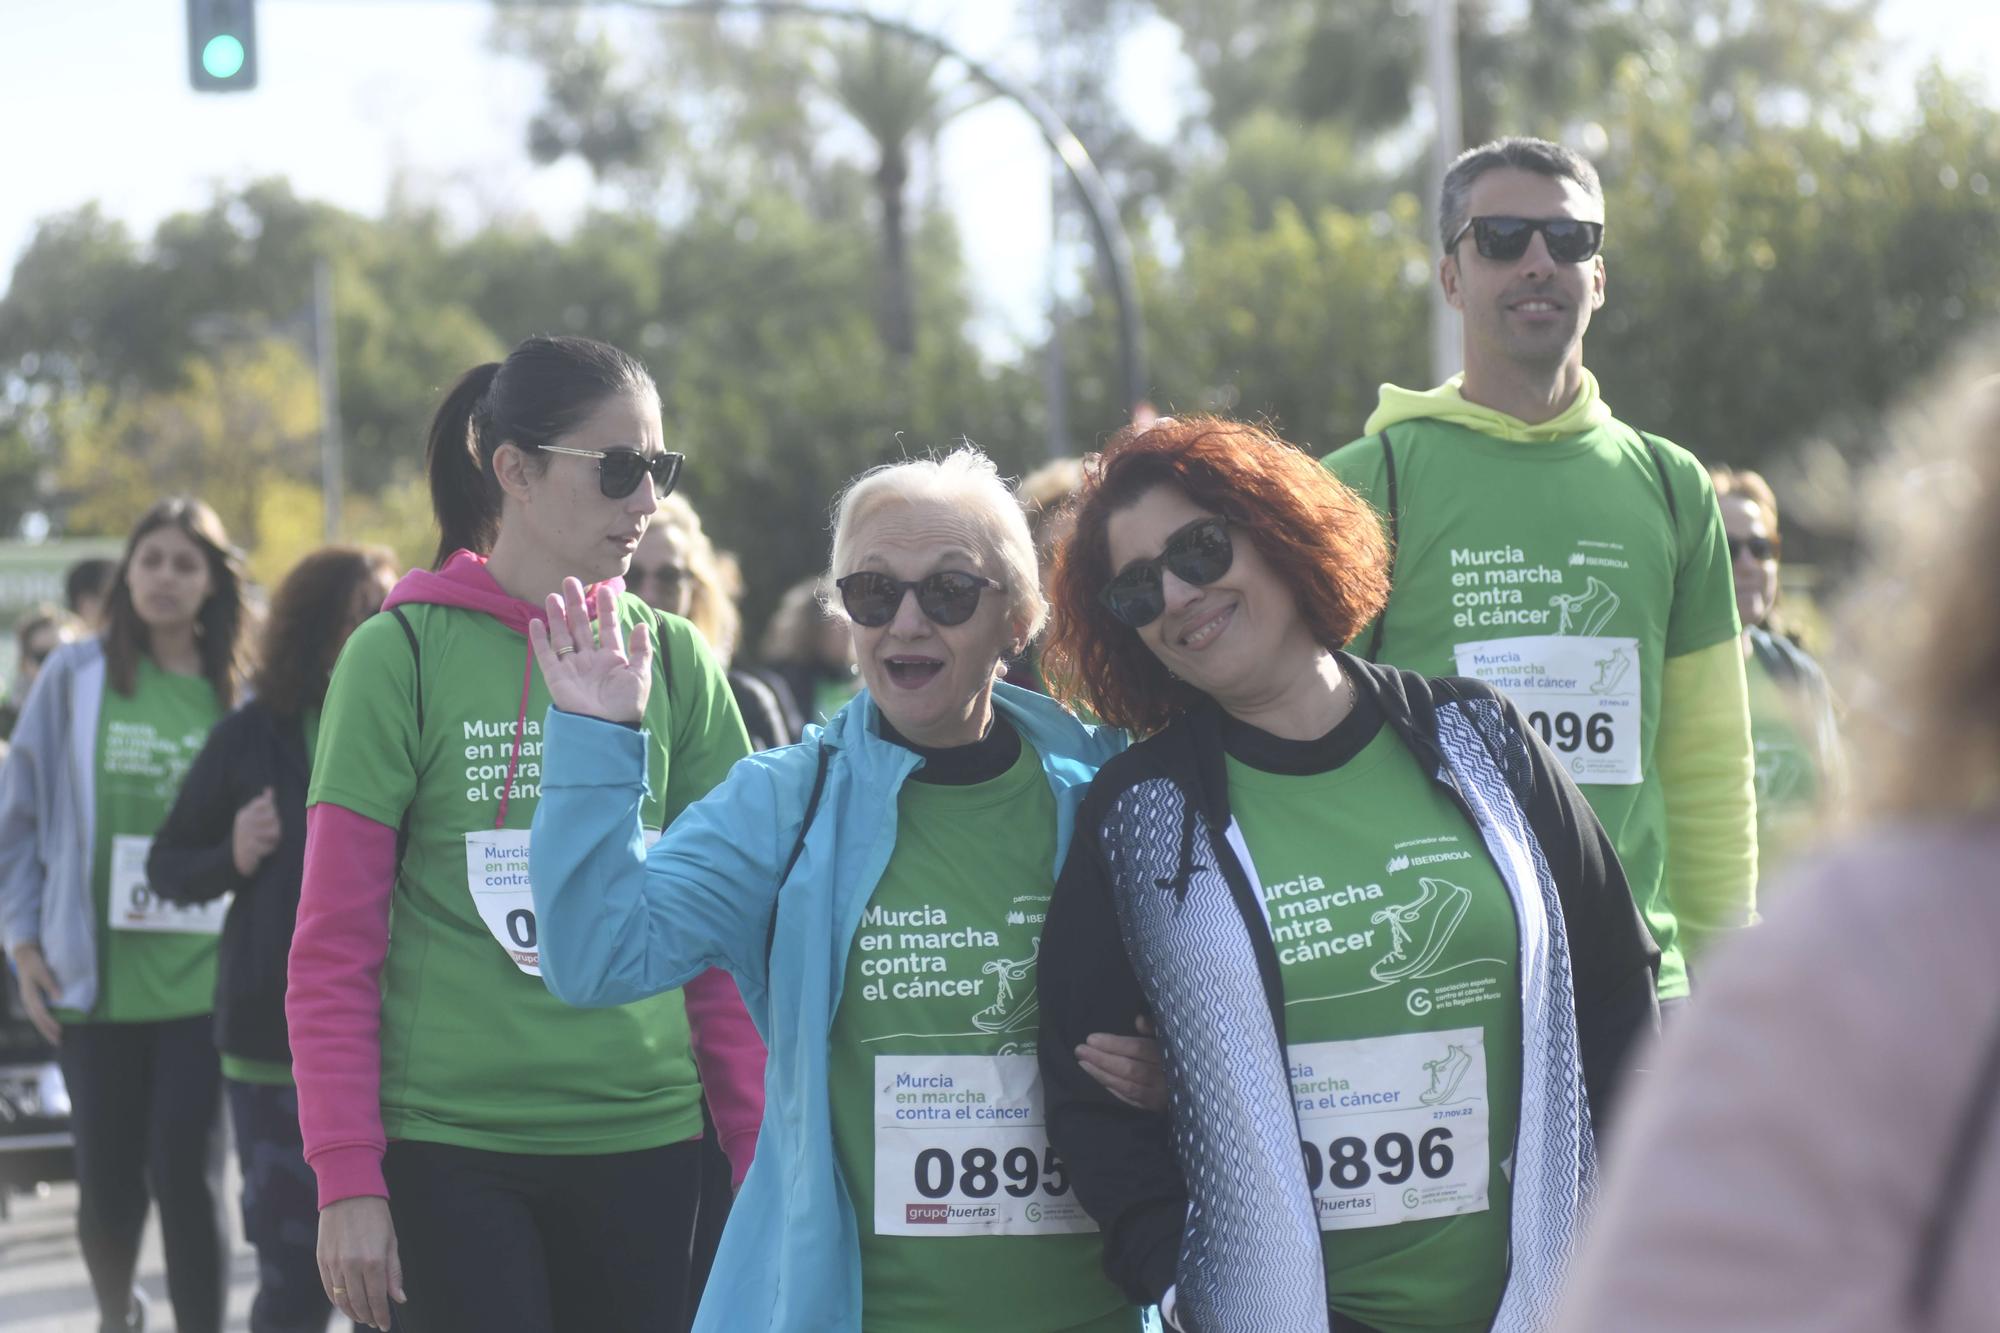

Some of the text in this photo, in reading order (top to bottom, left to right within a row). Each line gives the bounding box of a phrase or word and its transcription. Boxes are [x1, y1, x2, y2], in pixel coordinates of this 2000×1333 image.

[1451, 545, 1524, 567] Murcia
[1452, 566, 1562, 587] en marcha
[1452, 589, 1522, 607] contra
[1454, 606, 1550, 627] el cáncer
[1474, 652, 1520, 665] Murcia
[1476, 664, 1545, 676] en marcha
[1524, 676, 1534, 688] el
[1537, 677, 1577, 689] cáncer
[463, 716, 540, 739] Murcia
[464, 744, 493, 760] en
[466, 782, 489, 802] el
[485, 863, 502, 872] en
[1411, 851, 1472, 866] IBERDROLA
[1279, 884, 1383, 919] marcha
[861, 904, 947, 927] Murcia
[860, 927, 999, 951] en marcha
[1280, 930, 1375, 965] cáncer
[861, 955, 947, 976] contra
[863, 976, 984, 1001] el cáncer
[896, 1074, 953, 1088] Murcia
[896, 1089, 986, 1103] en marcha
[1319, 1094, 1336, 1109] el
[1341, 1090, 1400, 1107] cáncer
[896, 1105, 1030, 1119] contra el cáncer
[1432, 1108, 1472, 1120] 27.nov.22
[914, 1147, 1070, 1198] 0895
